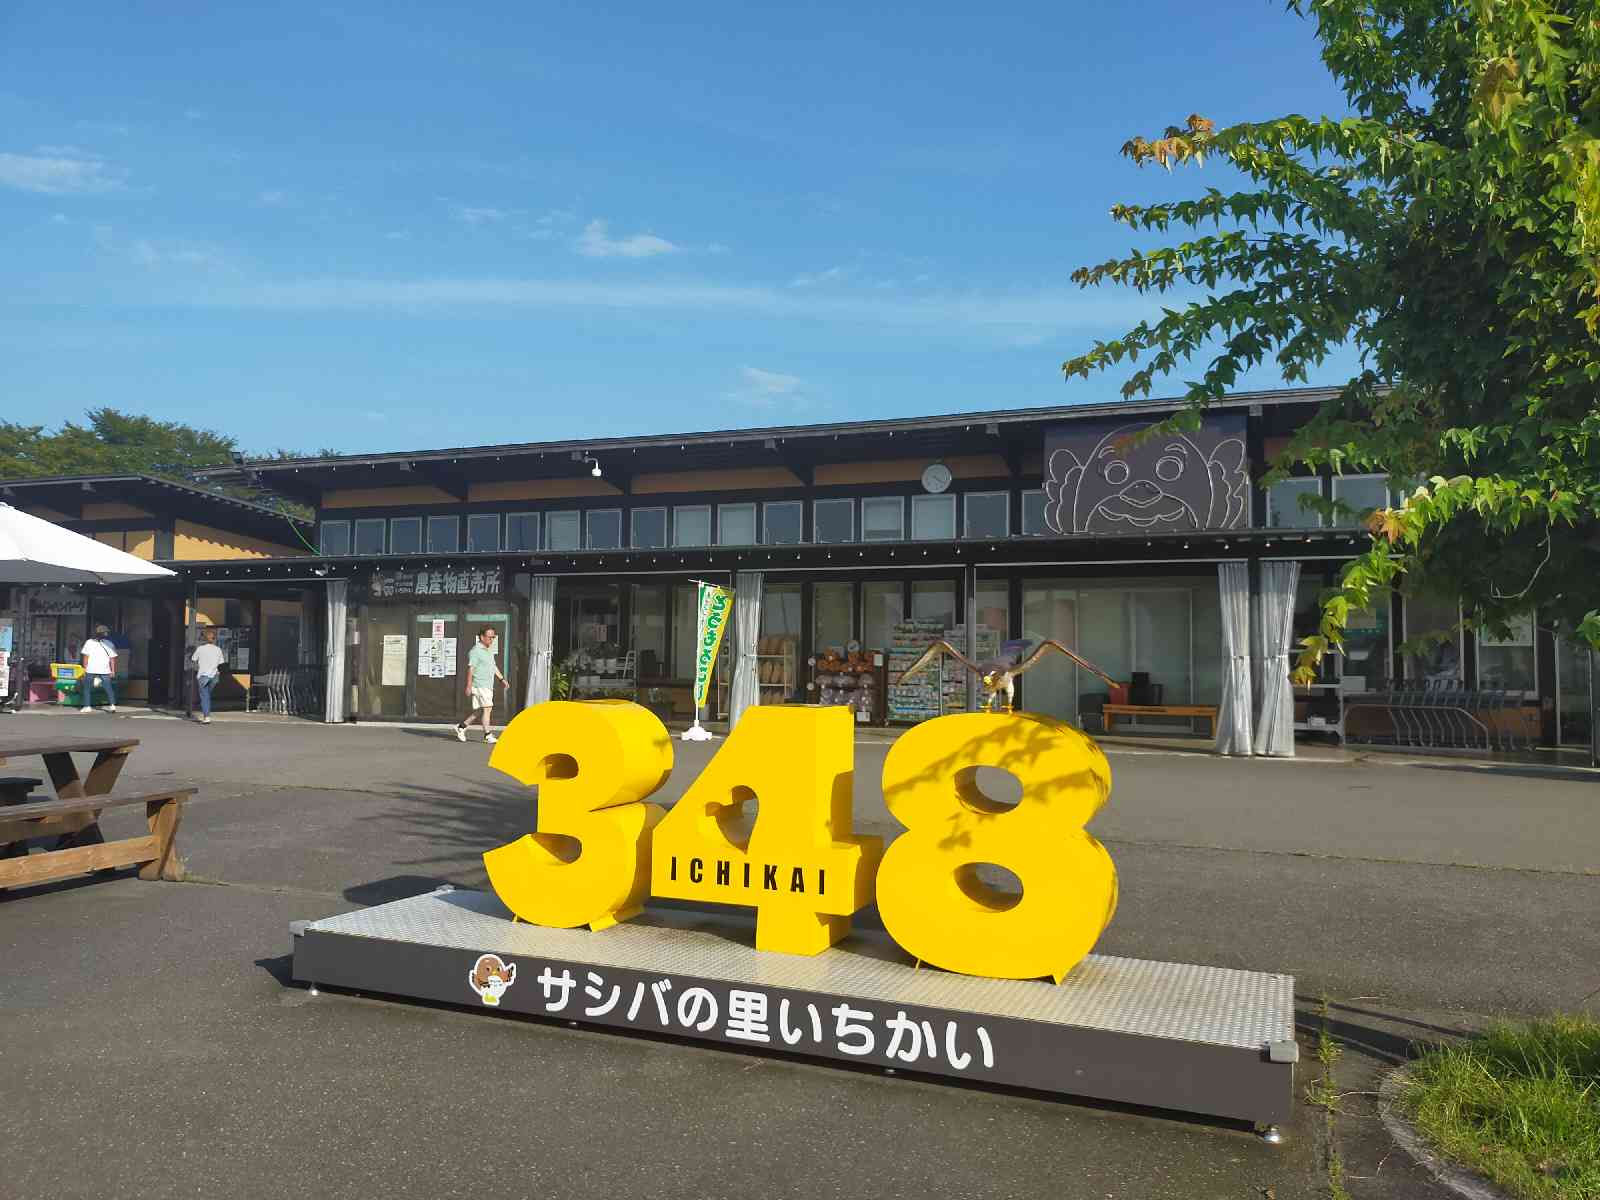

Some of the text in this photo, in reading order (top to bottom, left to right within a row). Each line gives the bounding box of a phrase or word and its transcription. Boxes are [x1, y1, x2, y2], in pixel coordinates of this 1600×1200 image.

[415, 571, 500, 595] 農産物直売所
[482, 698, 1118, 982] 348
[670, 856, 827, 896] ICHIKAI
[537, 966, 994, 1071] サシバの里いちかい
